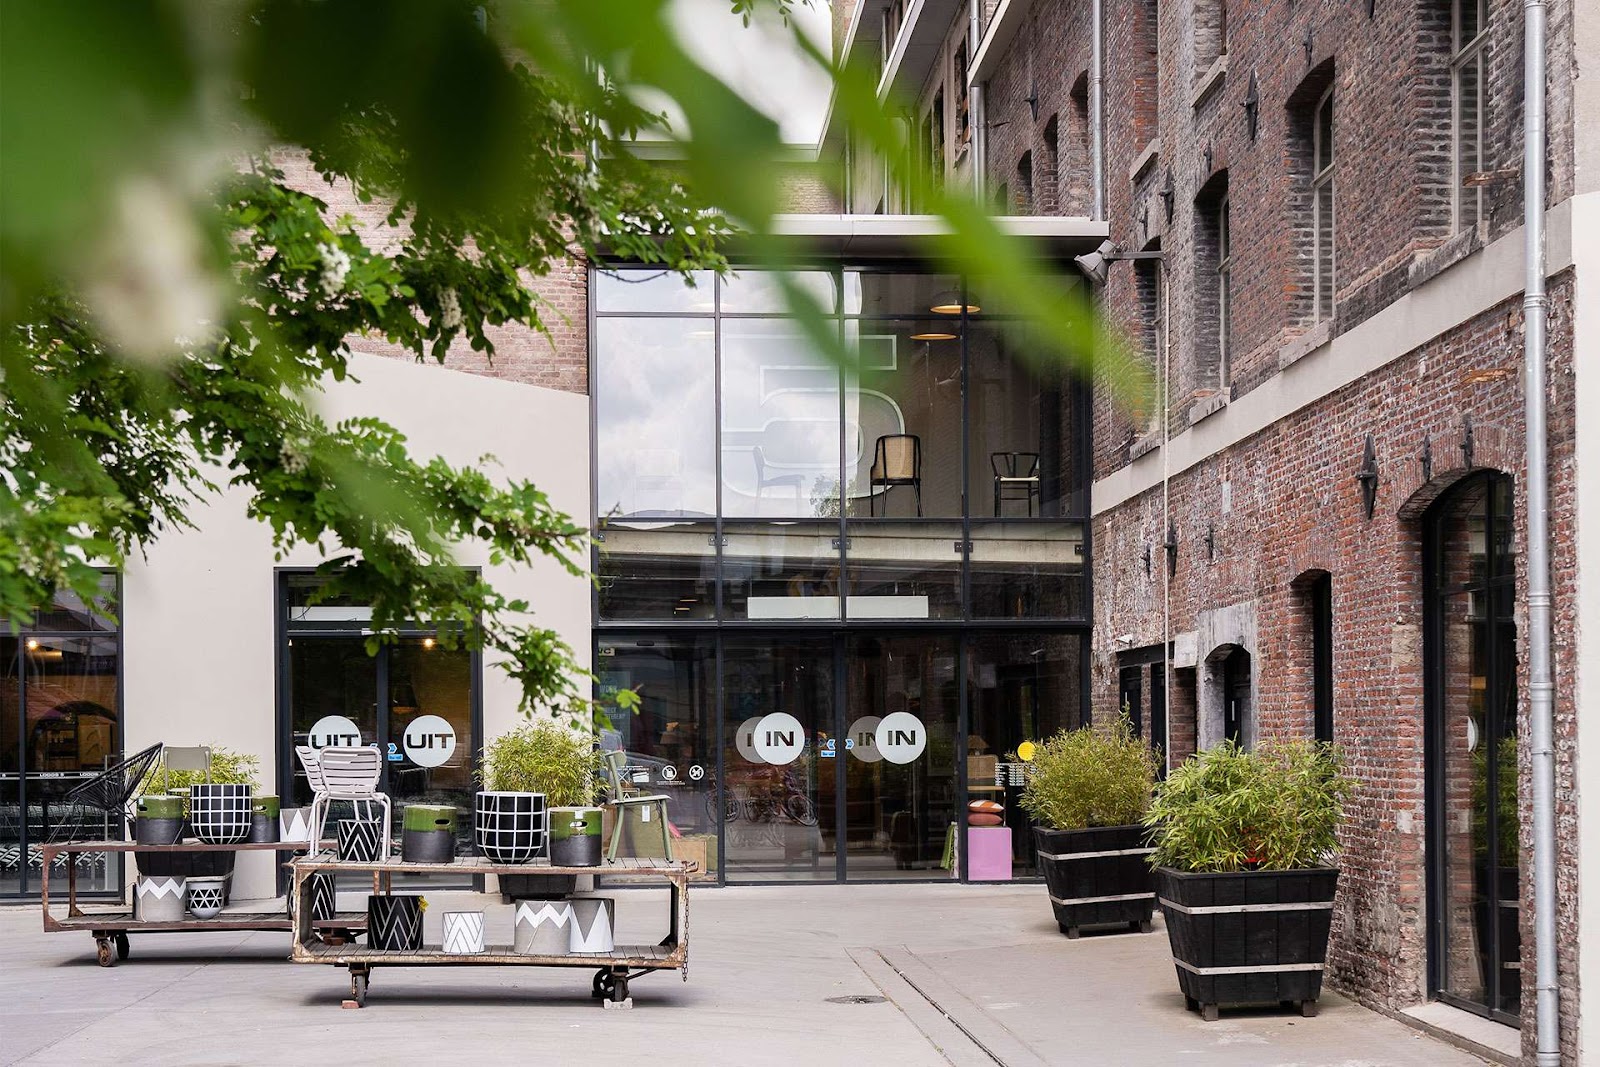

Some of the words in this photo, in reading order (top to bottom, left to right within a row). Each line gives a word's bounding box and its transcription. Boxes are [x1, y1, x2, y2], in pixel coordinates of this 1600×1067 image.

[311, 734, 359, 749] UIT
[406, 733, 453, 749] UIT
[766, 730, 794, 747] IN
[887, 730, 916, 746] IN
